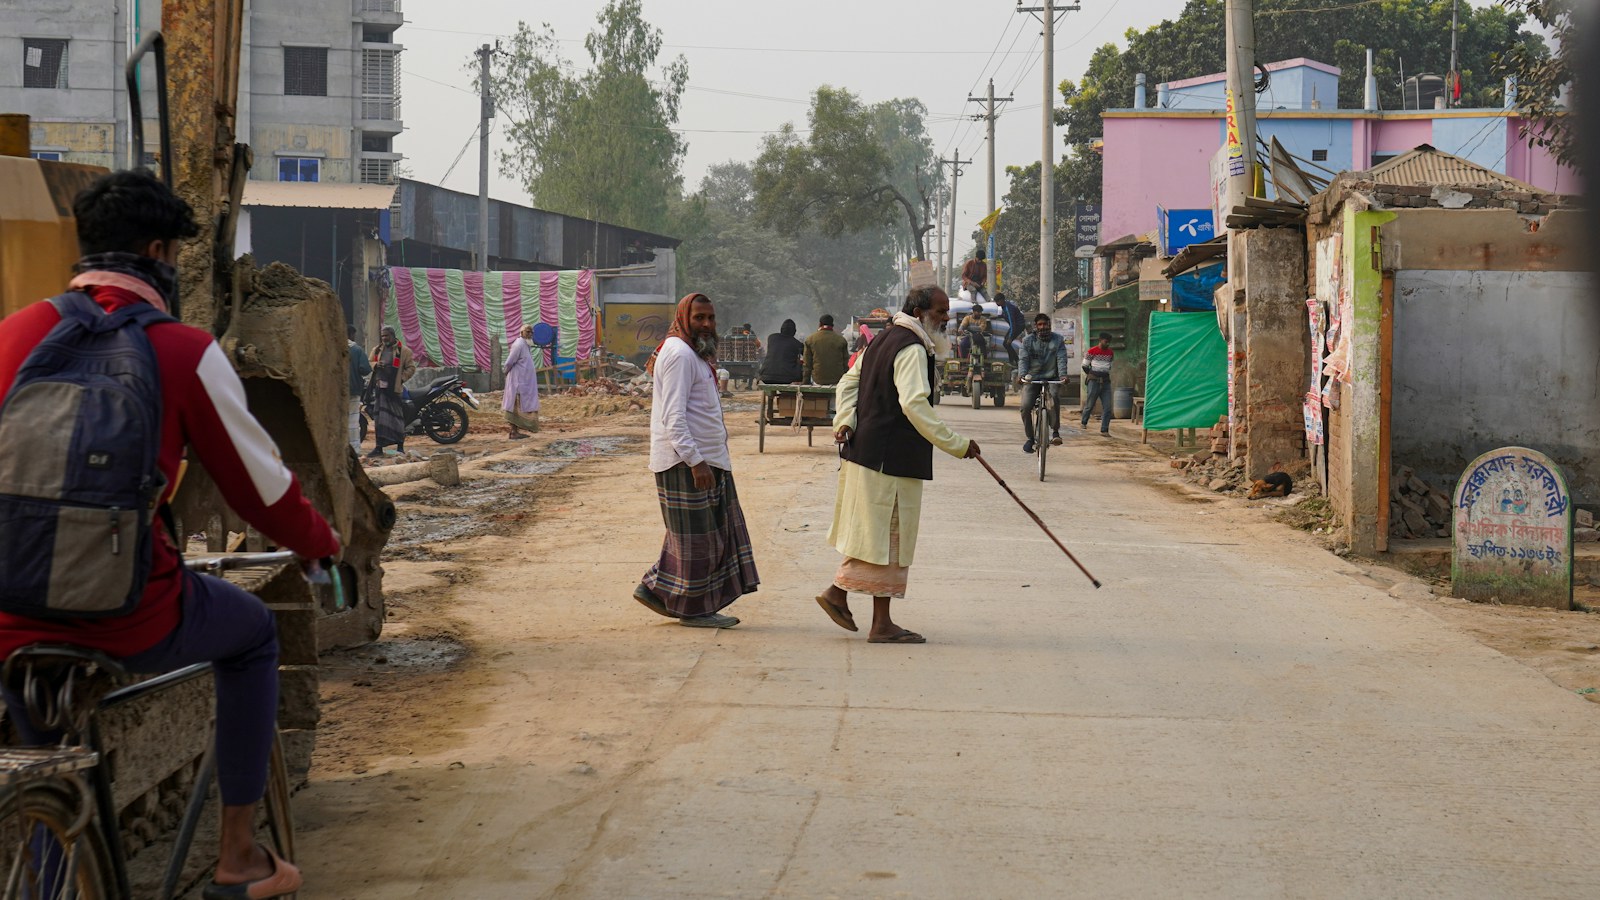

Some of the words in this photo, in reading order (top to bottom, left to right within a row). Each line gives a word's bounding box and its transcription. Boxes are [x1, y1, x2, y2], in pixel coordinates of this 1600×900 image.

[1079, 213, 1100, 222] সোনালী
[1081, 225, 1097, 233] ব্যাংক
[1520, 456, 1569, 517] সরকারী
[1457, 517, 1509, 538] প্রাথমিক
[1511, 518, 1564, 543] বিদ্যালয়
